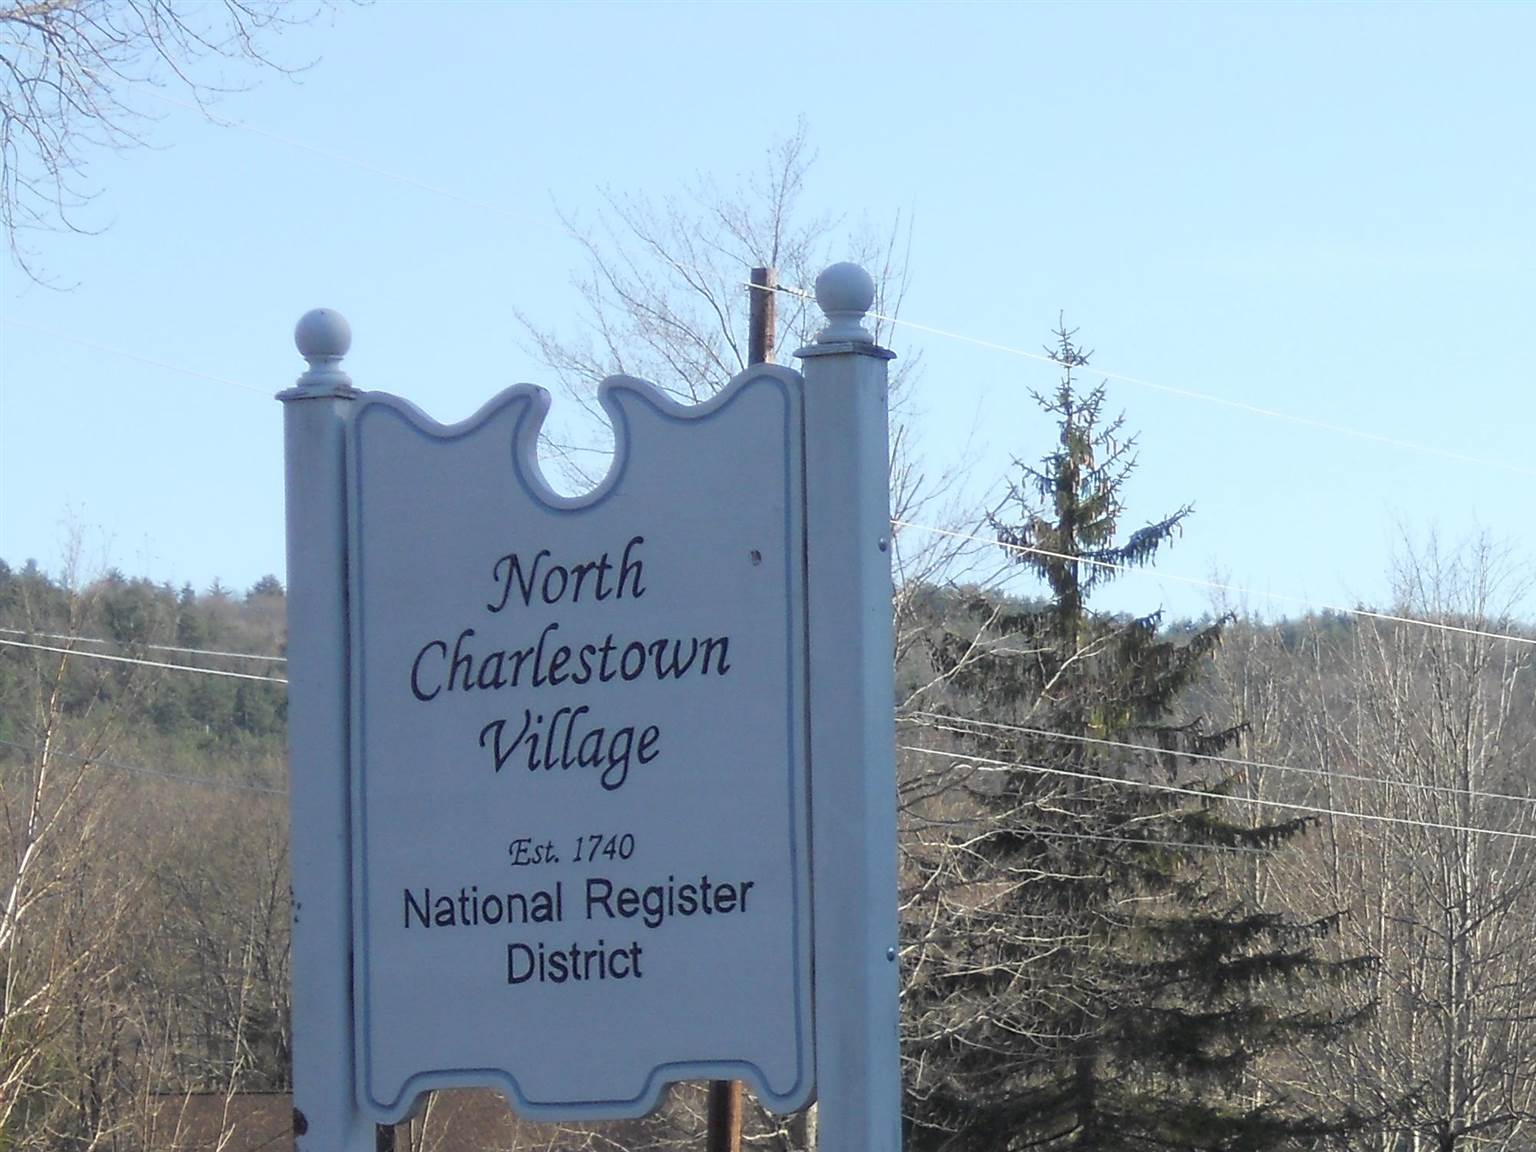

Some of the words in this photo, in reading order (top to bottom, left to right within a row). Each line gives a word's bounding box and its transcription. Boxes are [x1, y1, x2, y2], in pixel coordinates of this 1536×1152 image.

[487, 536, 647, 613] North
[411, 622, 731, 702] Charlestown
[479, 705, 660, 791] Village
[509, 838, 560, 867] Est.
[573, 833, 635, 863] 1740
[404, 881, 562, 929] National
[586, 875, 755, 929] Register
[508, 939, 642, 985] District
